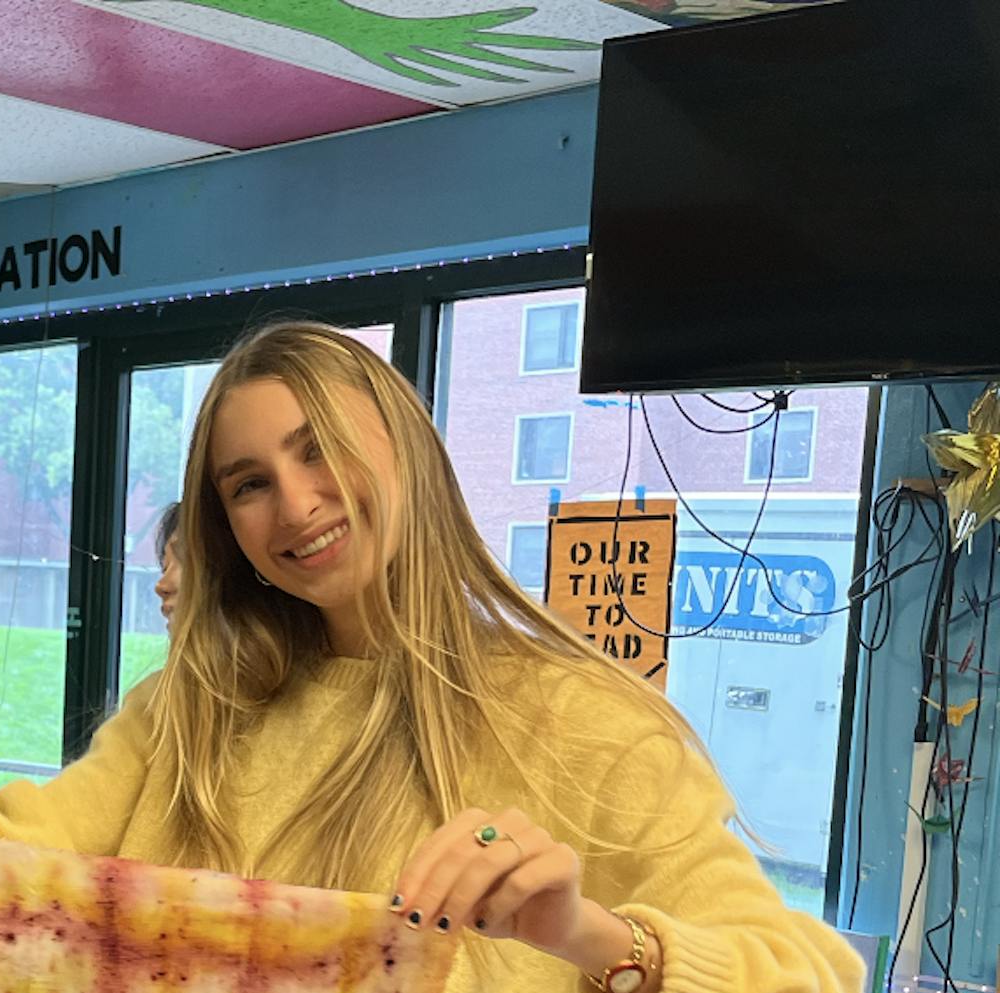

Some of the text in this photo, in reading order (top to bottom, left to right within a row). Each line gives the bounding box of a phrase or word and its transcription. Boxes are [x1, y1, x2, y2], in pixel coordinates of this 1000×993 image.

[570, 541, 651, 566] OUR
[568, 573, 648, 596] TIME
[585, 603, 625, 628] TO
[706, 626, 755, 640] PORTABLE
[756, 630, 801, 643] STORAGE
